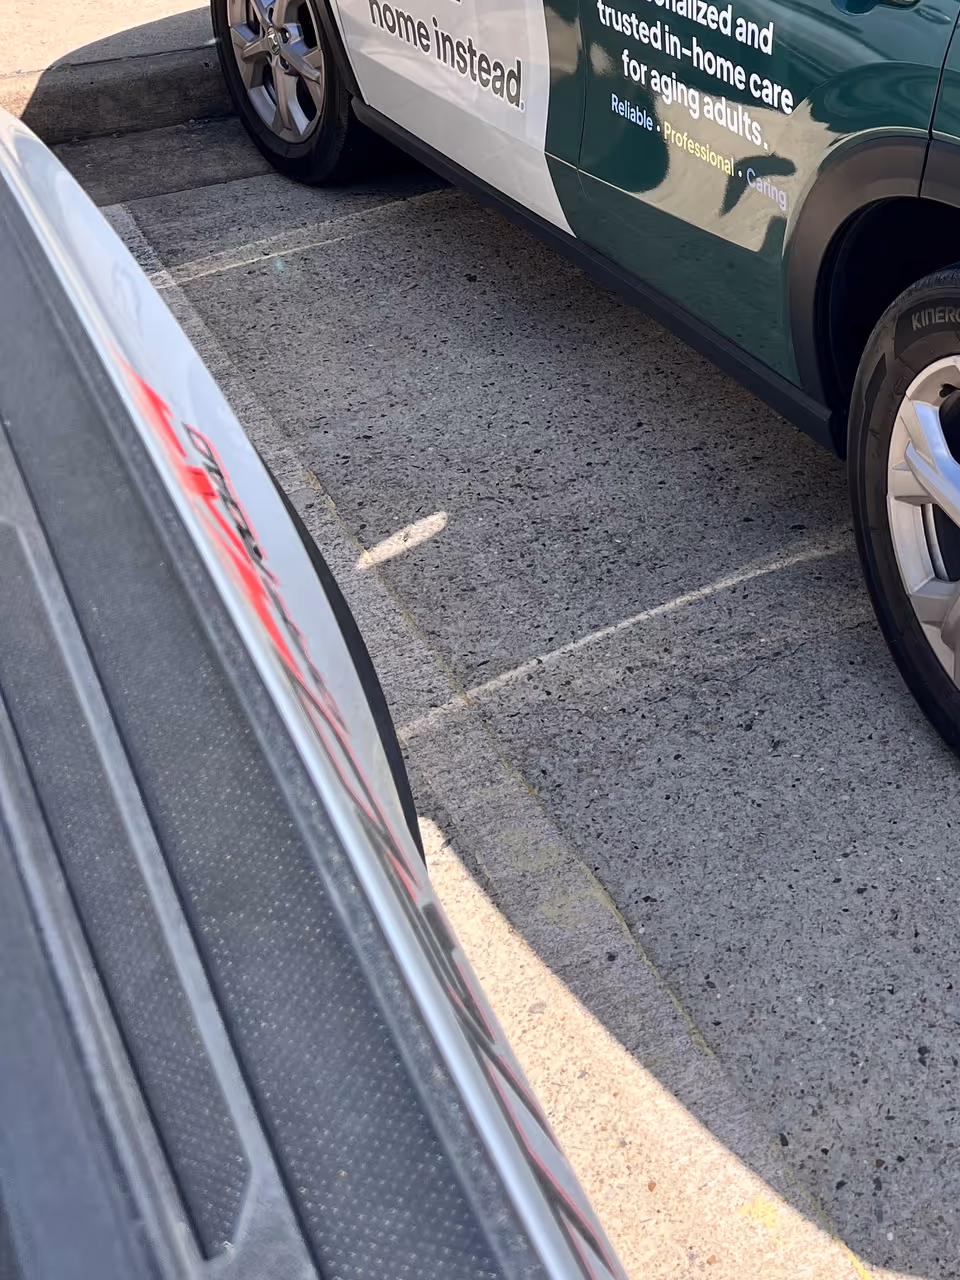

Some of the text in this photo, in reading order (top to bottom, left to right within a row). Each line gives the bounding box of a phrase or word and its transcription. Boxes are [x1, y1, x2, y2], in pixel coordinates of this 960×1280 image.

[432, 17, 522, 109] instead
[664, 25, 746, 91] in-home
[749, 73, 794, 115] care
[735, 20, 774, 55] and
[621, 48, 769, 151] for aging adults.
[611, 92, 787, 212] Reliable Professional Caring
